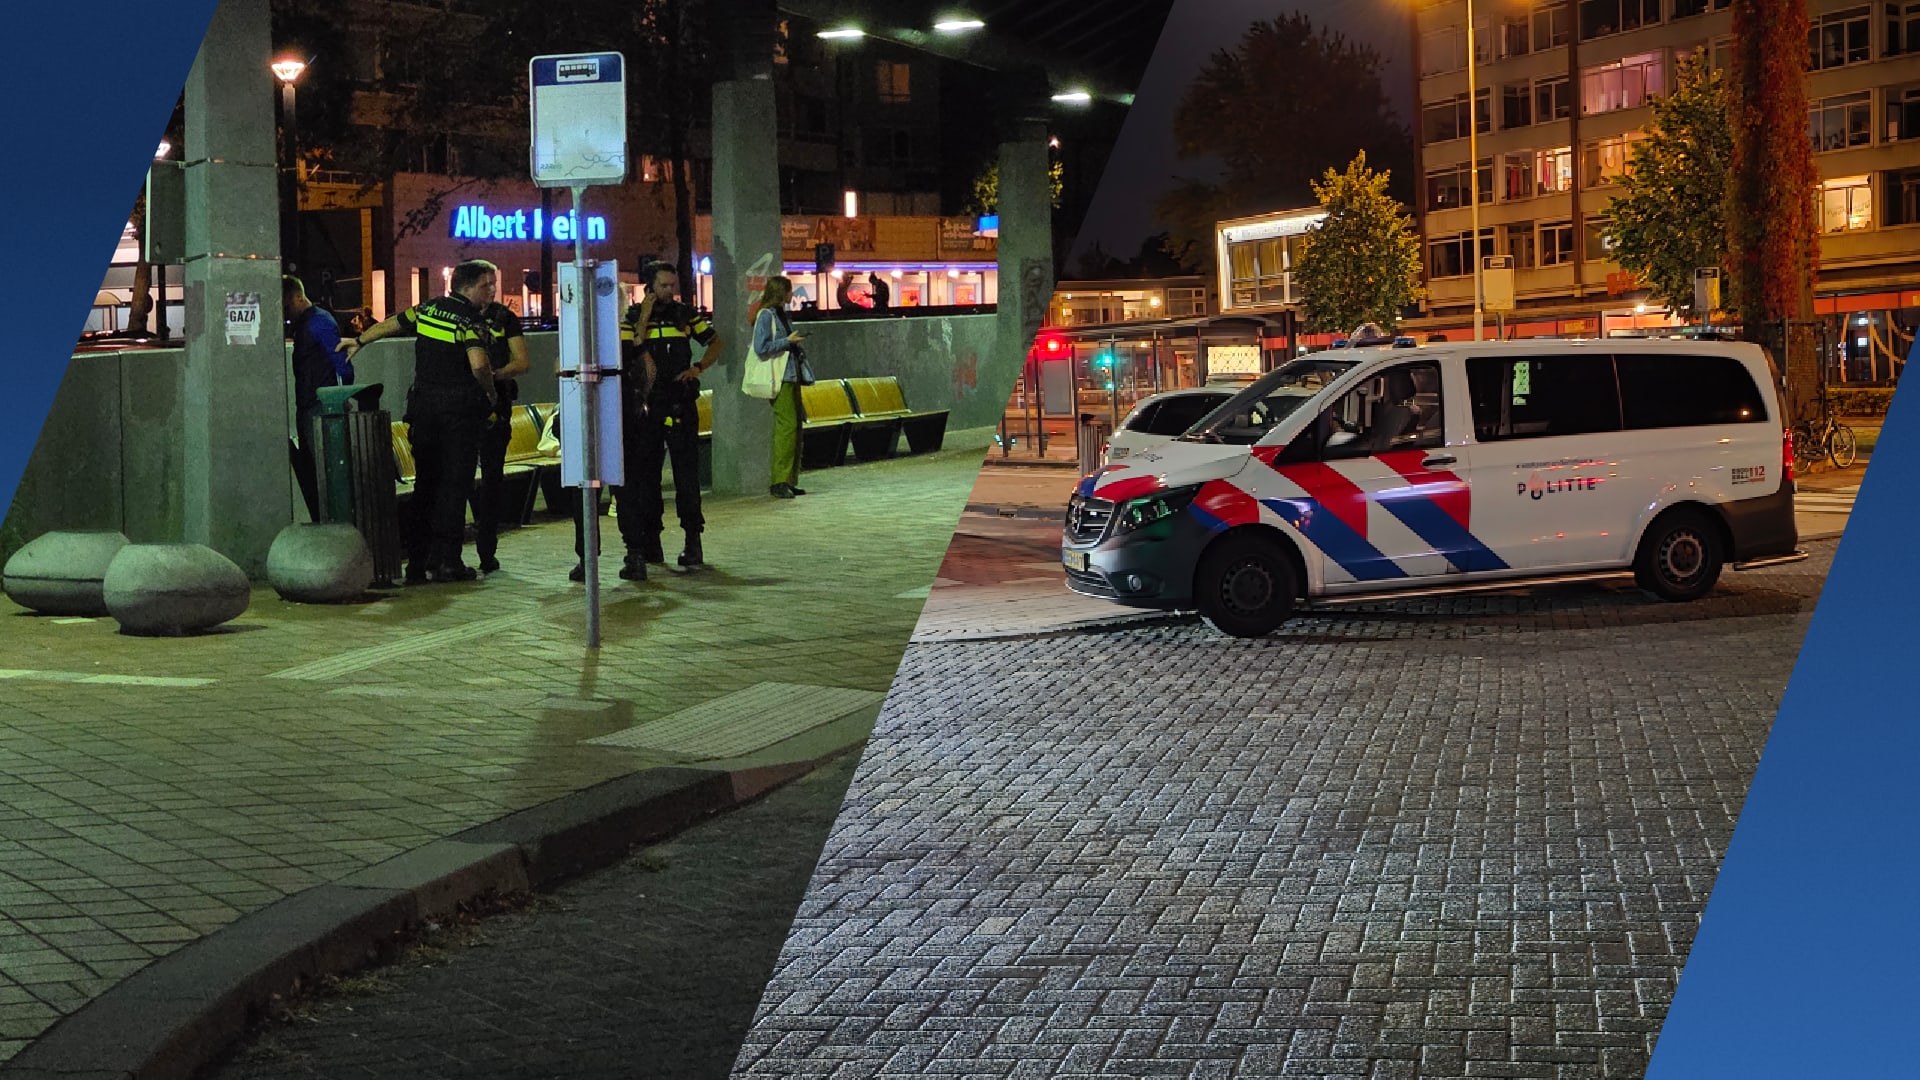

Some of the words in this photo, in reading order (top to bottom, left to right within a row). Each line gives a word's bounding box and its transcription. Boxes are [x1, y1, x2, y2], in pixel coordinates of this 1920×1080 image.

[454, 205, 527, 239] Albert
[229, 310, 256, 323] GAZA
[1517, 477, 1596, 500] POLITIE
